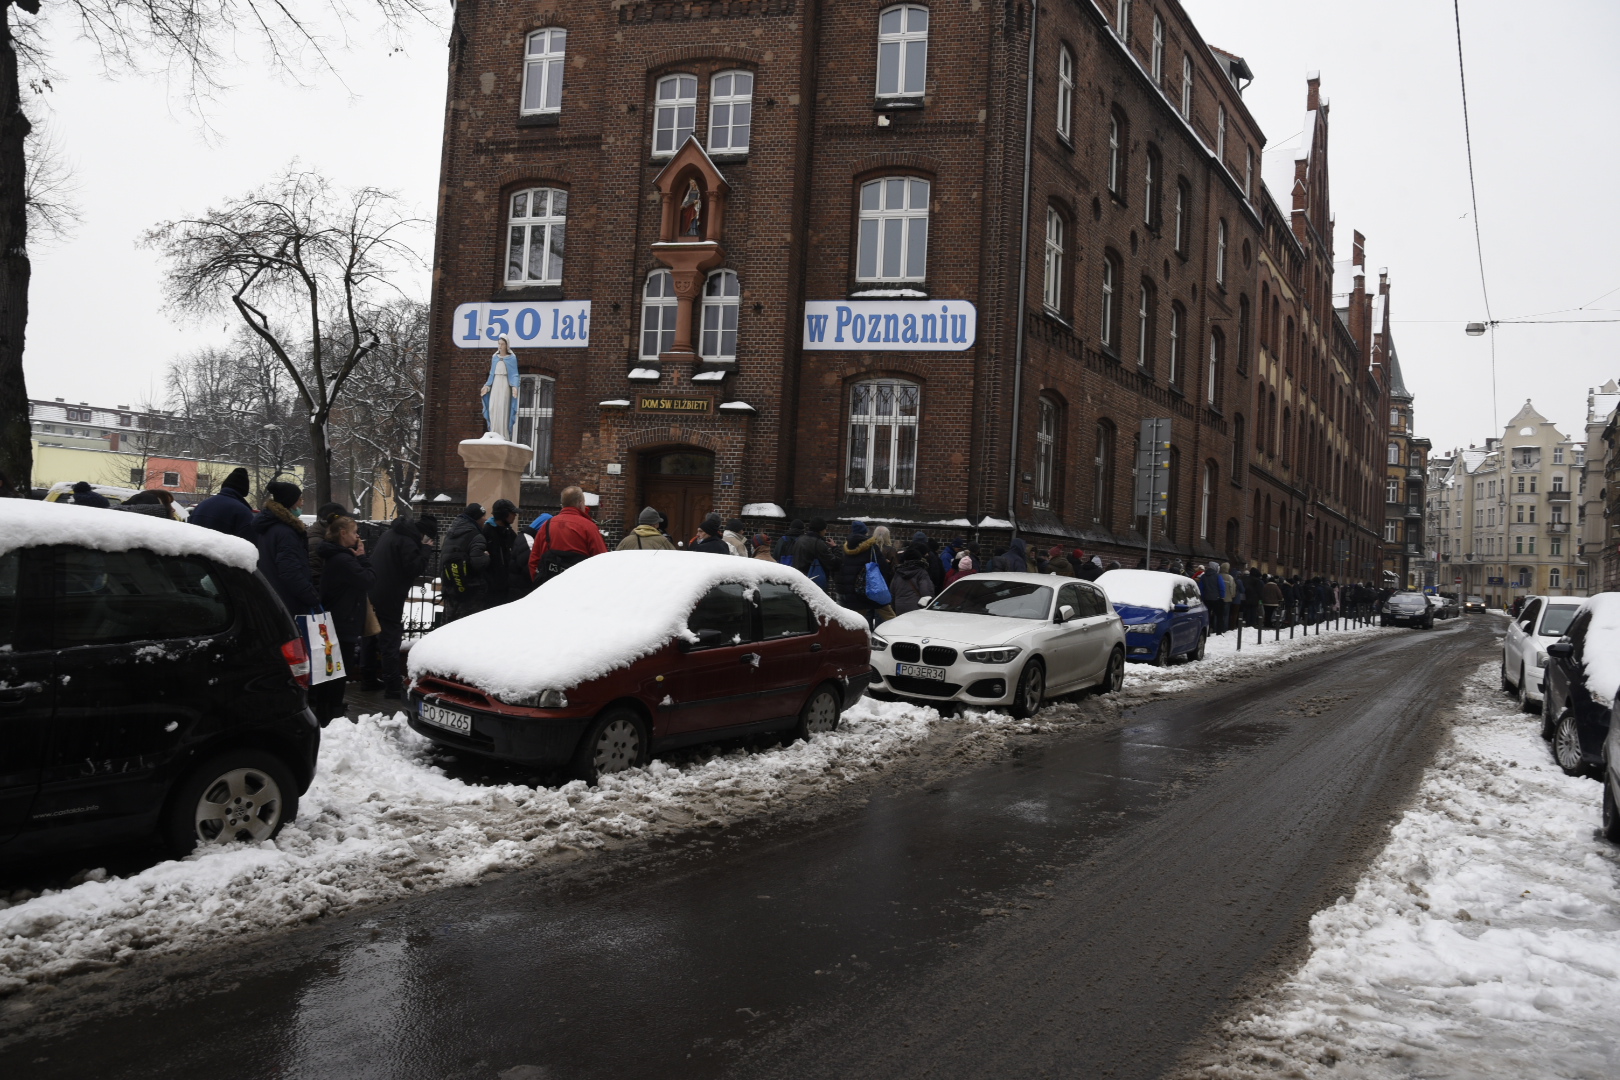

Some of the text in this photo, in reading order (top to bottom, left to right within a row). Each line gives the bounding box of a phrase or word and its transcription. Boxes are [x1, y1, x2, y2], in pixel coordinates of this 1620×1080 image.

[462, 308, 588, 341] 150 lat
[807, 305, 967, 343] w Poznaniu
[641, 398, 659, 409] DOM
[901, 665, 943, 680] PO 3ER34
[423, 703, 469, 730] PO 9T265
